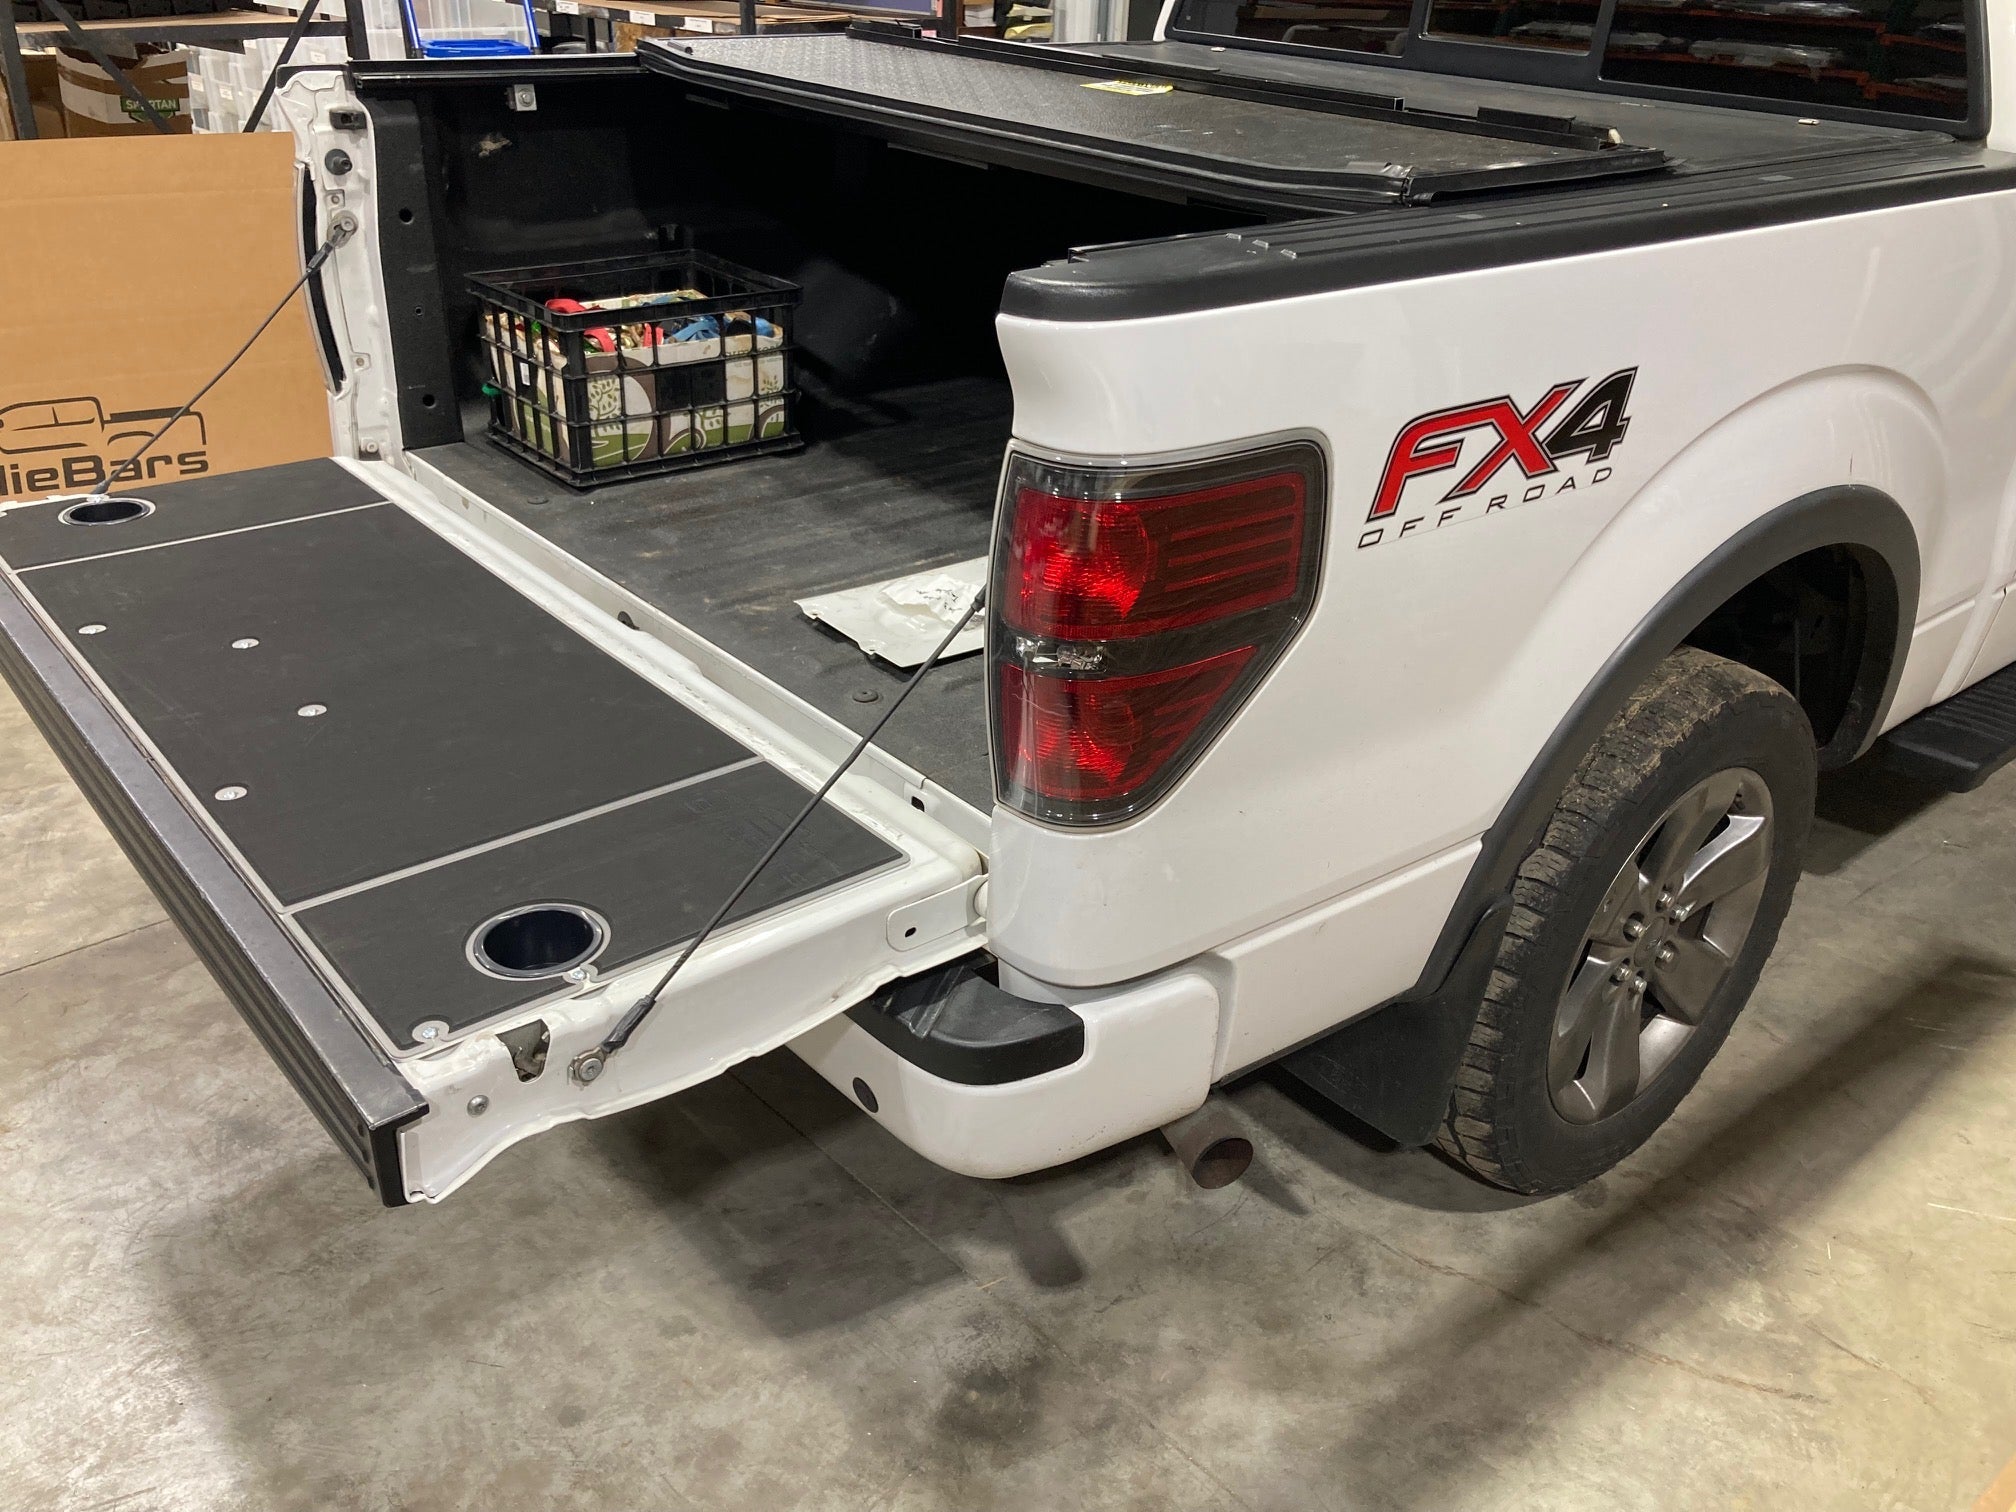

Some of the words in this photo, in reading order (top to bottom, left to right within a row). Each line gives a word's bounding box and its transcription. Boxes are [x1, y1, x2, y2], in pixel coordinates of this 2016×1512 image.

[126, 99, 177, 110] SPRTAN
[1366, 366, 1639, 523] FX4
[1357, 506, 1462, 549] OFF
[1486, 467, 1612, 513] ROAD
